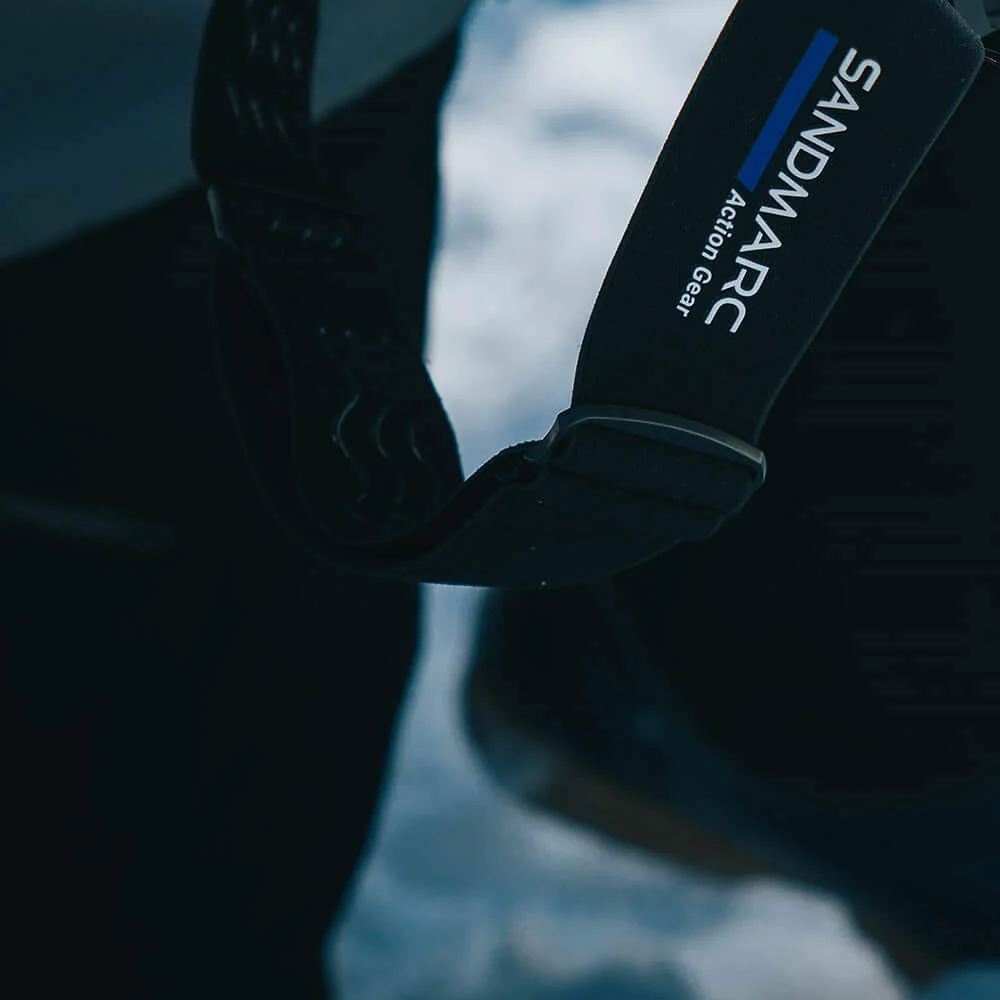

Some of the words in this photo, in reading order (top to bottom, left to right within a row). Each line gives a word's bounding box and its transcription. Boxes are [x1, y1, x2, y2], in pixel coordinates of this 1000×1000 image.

[701, 188, 746, 260] Action
[704, 47, 881, 334] SANDMARC
[676, 266, 712, 317] Gear
